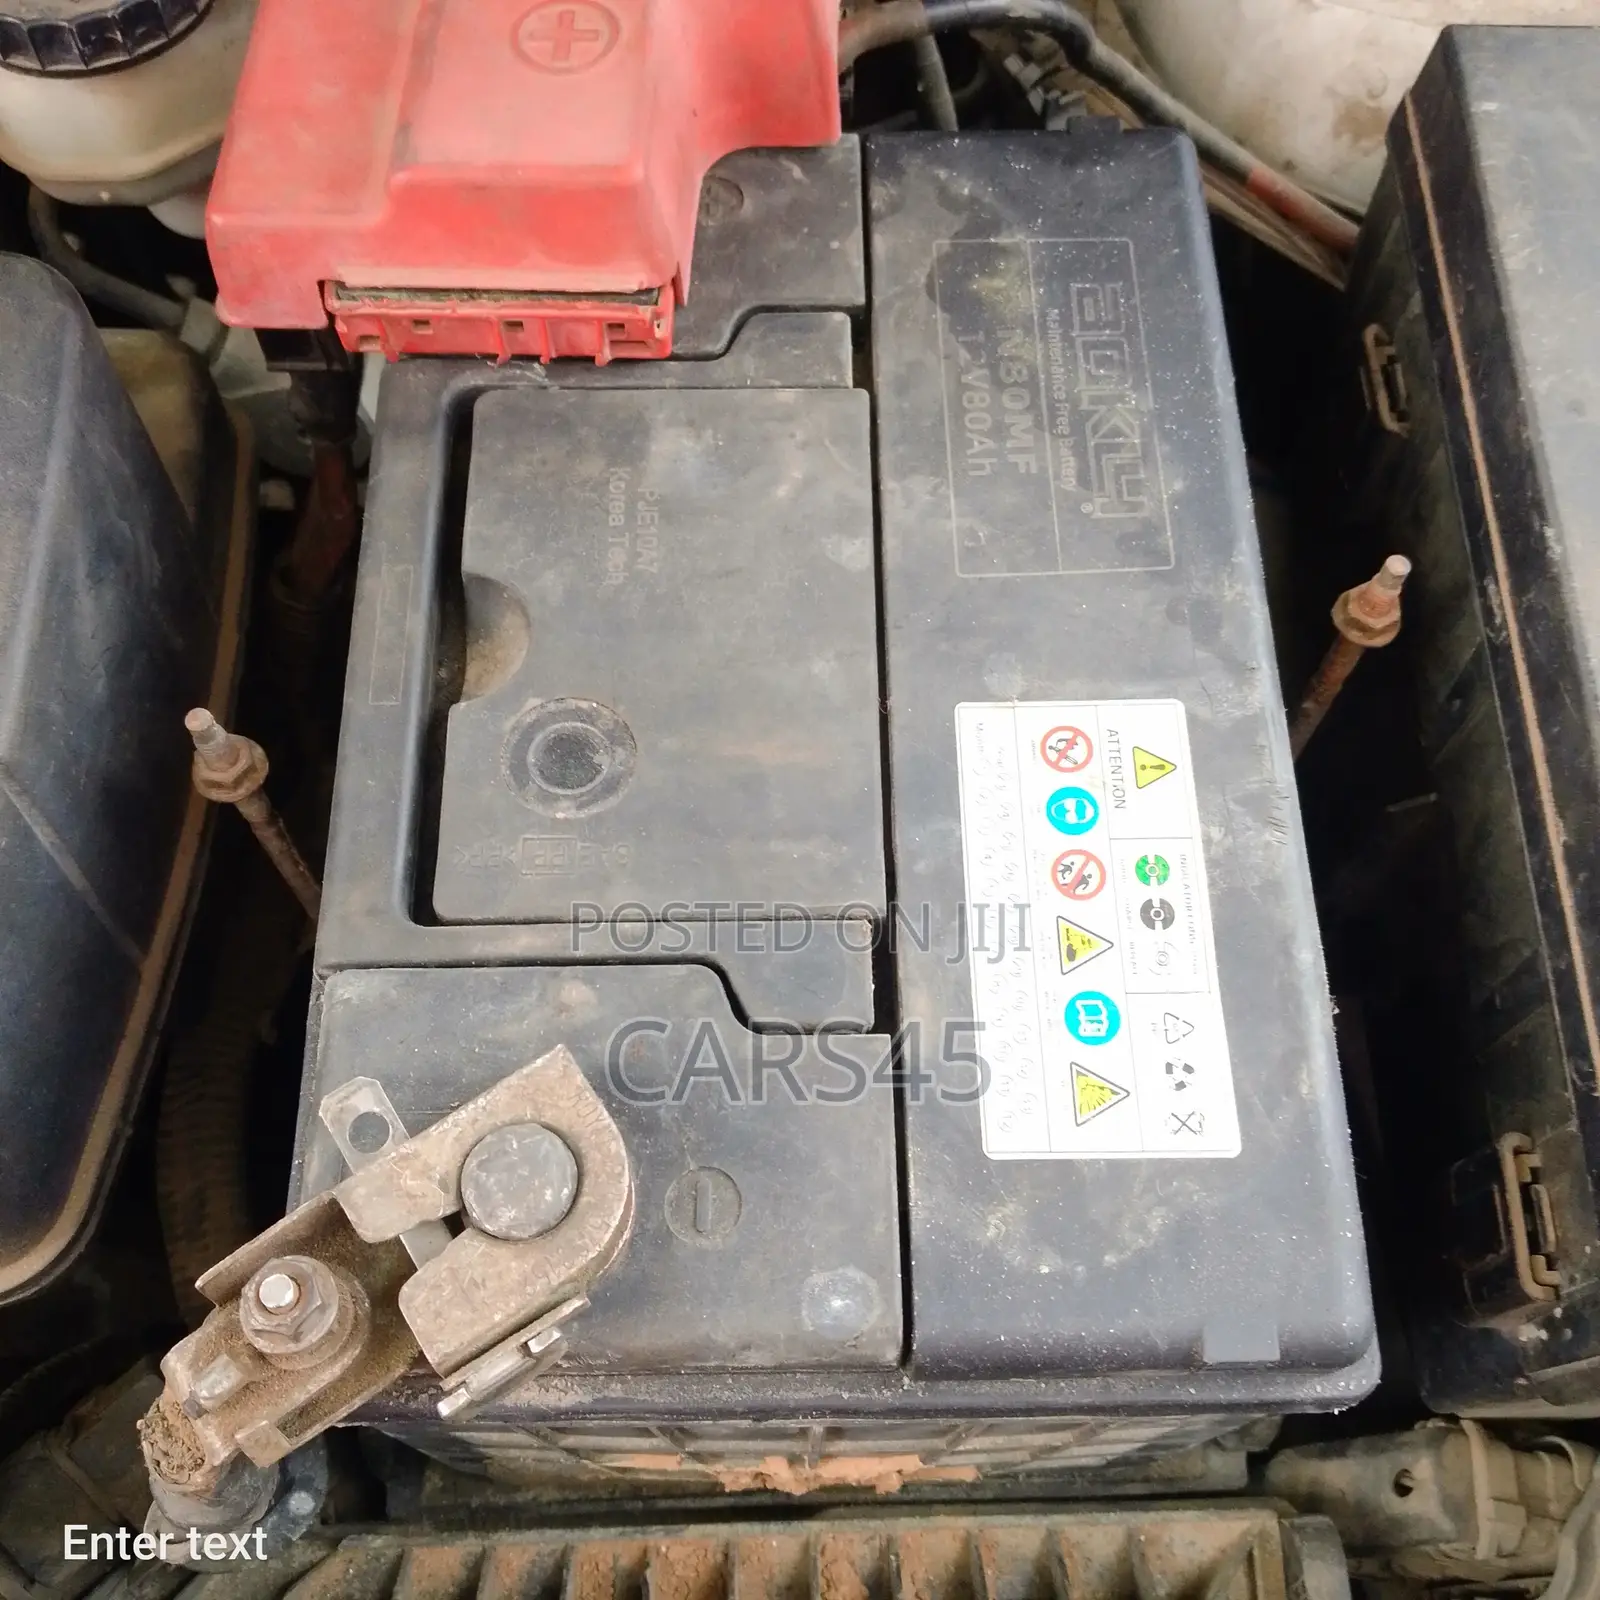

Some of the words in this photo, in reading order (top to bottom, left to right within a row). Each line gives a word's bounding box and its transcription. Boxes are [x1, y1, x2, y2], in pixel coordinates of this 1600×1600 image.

[1046, 306, 1066, 400] Maintenance
[957, 330, 998, 476] 12V80Ah
[997, 326, 1038, 474] N80MF
[1055, 402, 1070, 435] Free
[608, 467, 632, 527] Korea
[1060, 437, 1078, 492] Battery
[1106, 728, 1127, 810] ATTENTION
